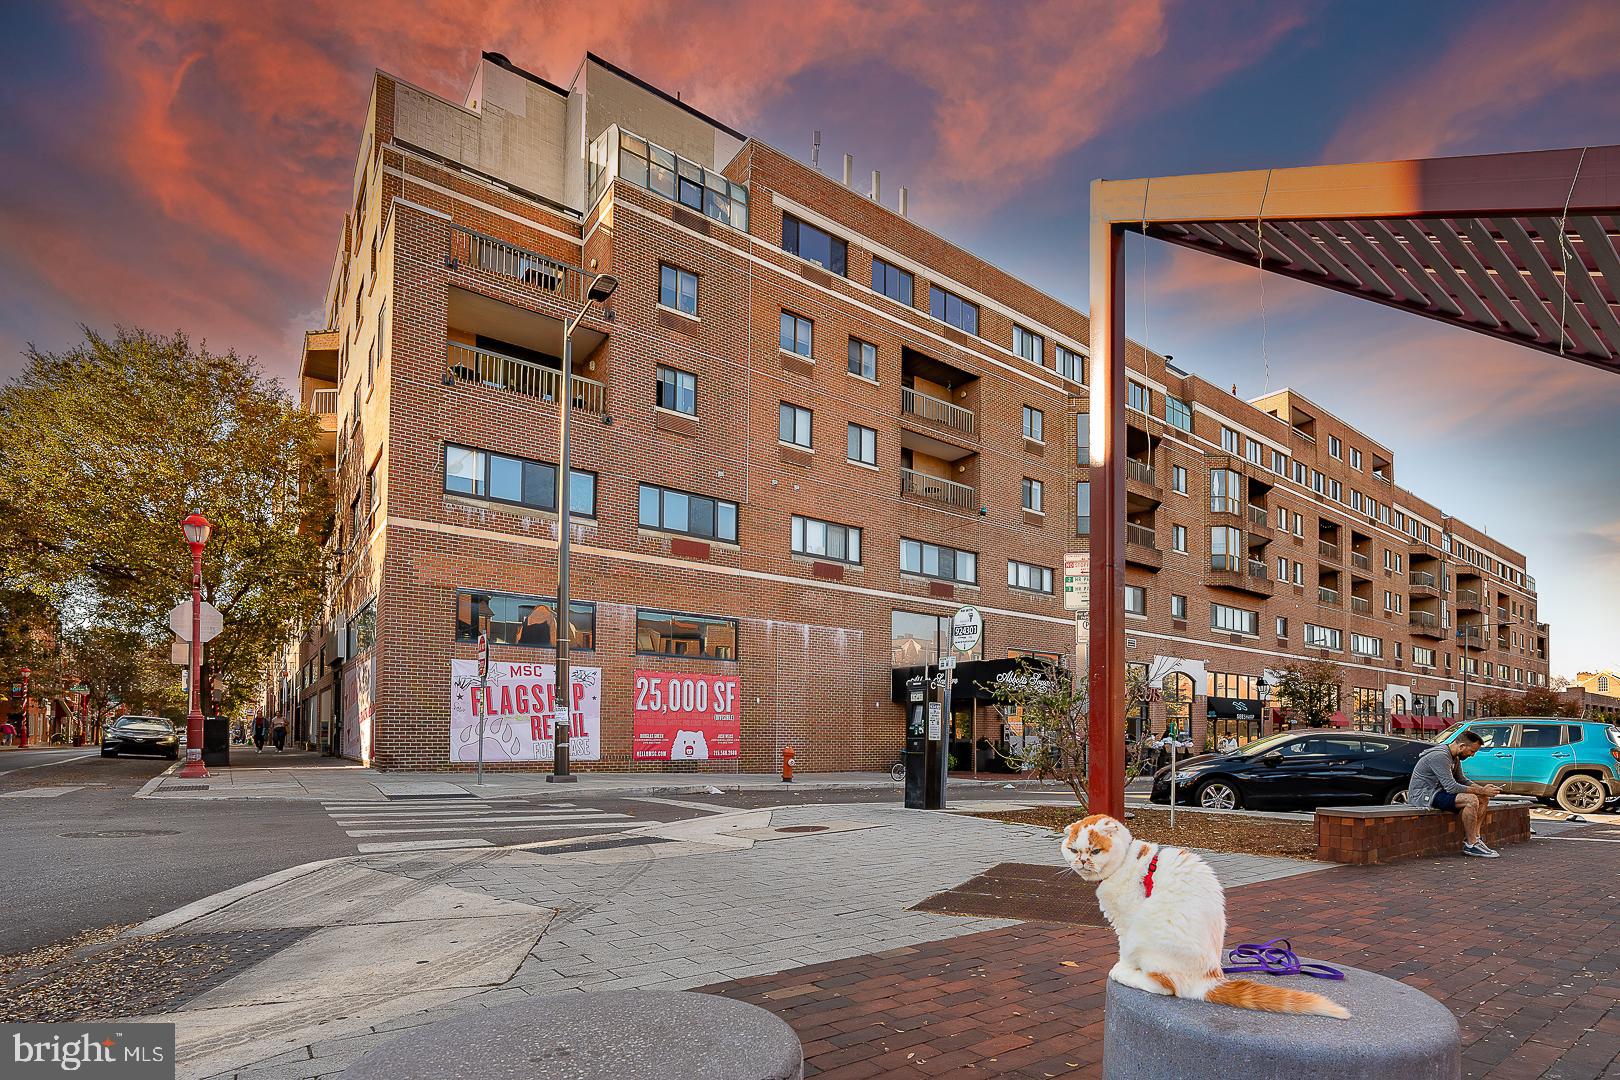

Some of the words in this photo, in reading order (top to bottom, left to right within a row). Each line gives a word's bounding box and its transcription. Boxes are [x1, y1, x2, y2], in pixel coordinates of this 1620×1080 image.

[955, 625, 977, 636] 924301
[510, 665, 543, 677] MSC
[470, 683, 586, 716] FLAGSHP
[635, 676, 709, 714] 25,000
[713, 681, 736, 712] SF
[532, 742, 556, 760] FOR
